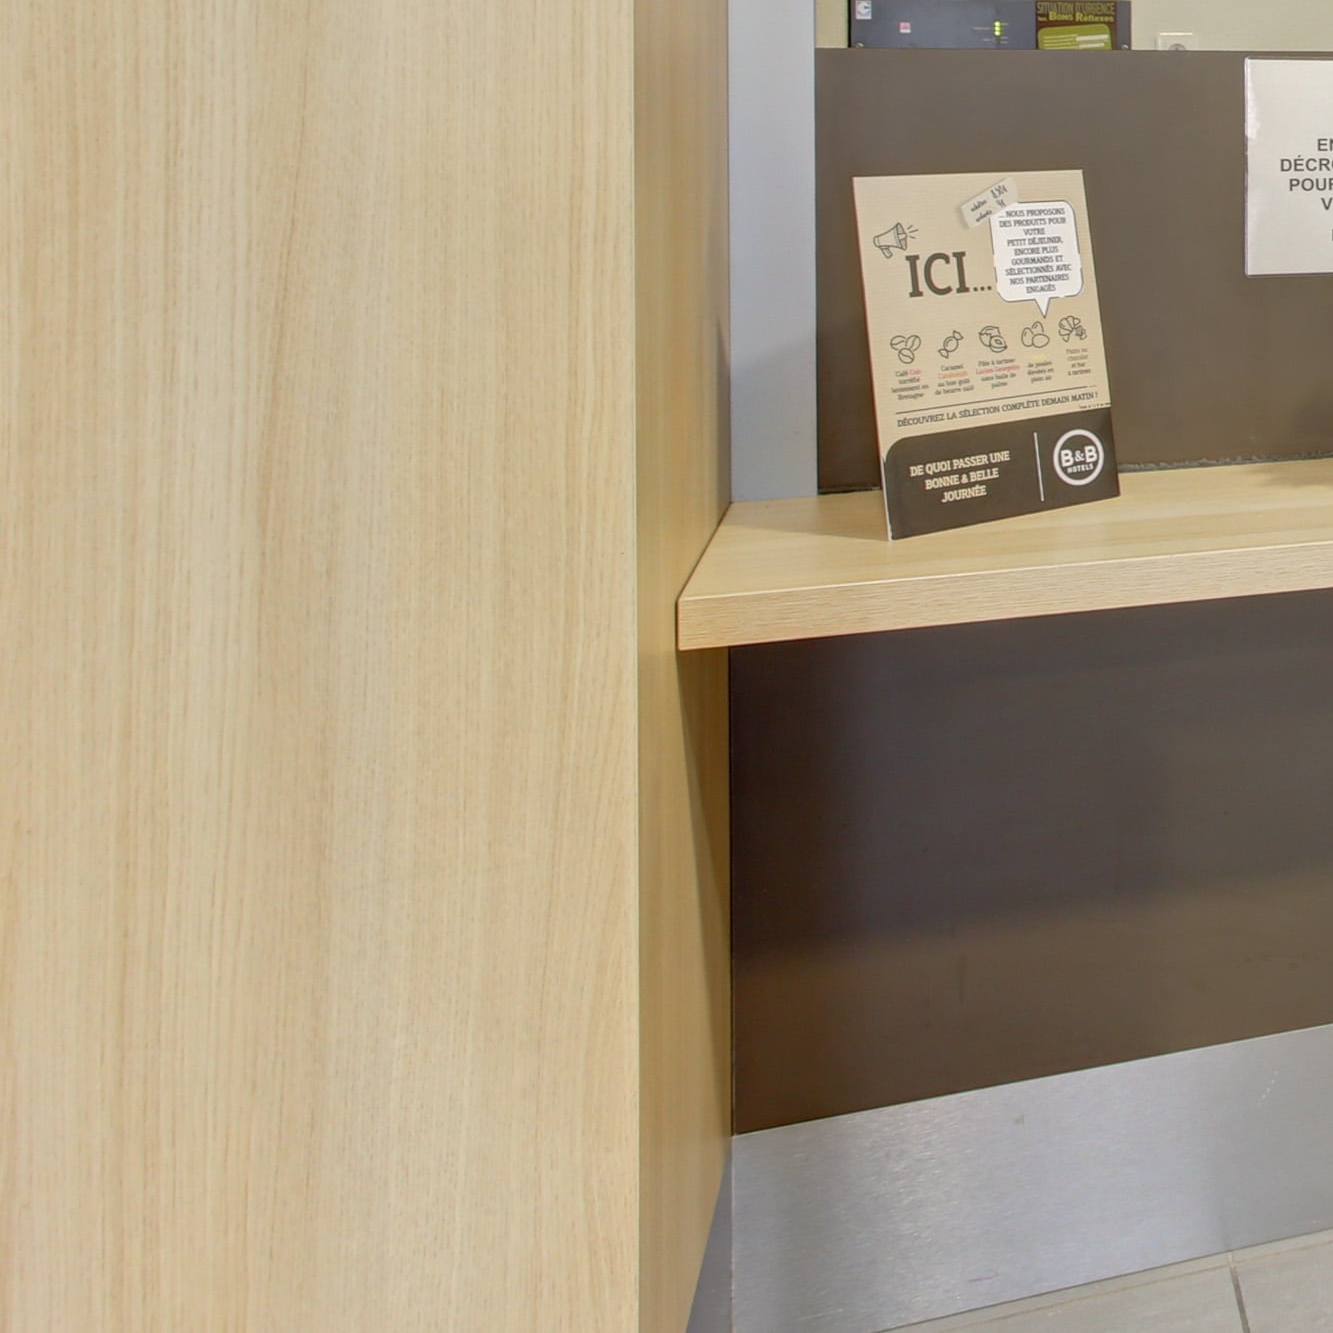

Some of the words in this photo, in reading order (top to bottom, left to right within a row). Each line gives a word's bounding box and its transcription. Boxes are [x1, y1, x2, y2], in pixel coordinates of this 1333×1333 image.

[1026, 208, 1065, 216] PROPOSONS
[1014, 218, 1047, 226] PRODUITS
[1048, 217, 1066, 225] POUR
[1014, 248, 1040, 256] ENCORE
[1042, 246, 1059, 254] PLUS
[1011, 257, 1054, 266] GOURMANDS
[905, 252, 992, 298] ICI...
[1026, 274, 1069, 283] PARTENAIRES
[1026, 284, 1056, 294] ENGAGÉS
[898, 412, 945, 427] DÉCOUVREZ
[947, 412, 957, 420] LA
[959, 405, 1000, 418] SÉLECTION
[1002, 399, 1040, 413] COMPLÈTE
[1041, 395, 1070, 406] DEMAIN
[1071, 392, 1094, 402] MATIN
[1060, 445, 1098, 467] B&B
[910, 465, 924, 477] DE
[925, 461, 951, 475] QUOI
[953, 454, 988, 471] PASSER
[990, 451, 1010, 463] UNE
[1067, 463, 1094, 474] HOTELS
[925, 474, 960, 490] BONNE
[961, 474, 968, 483] &
[970, 468, 999, 481] BELLE
[941, 485, 987, 502] JOURNÉE
